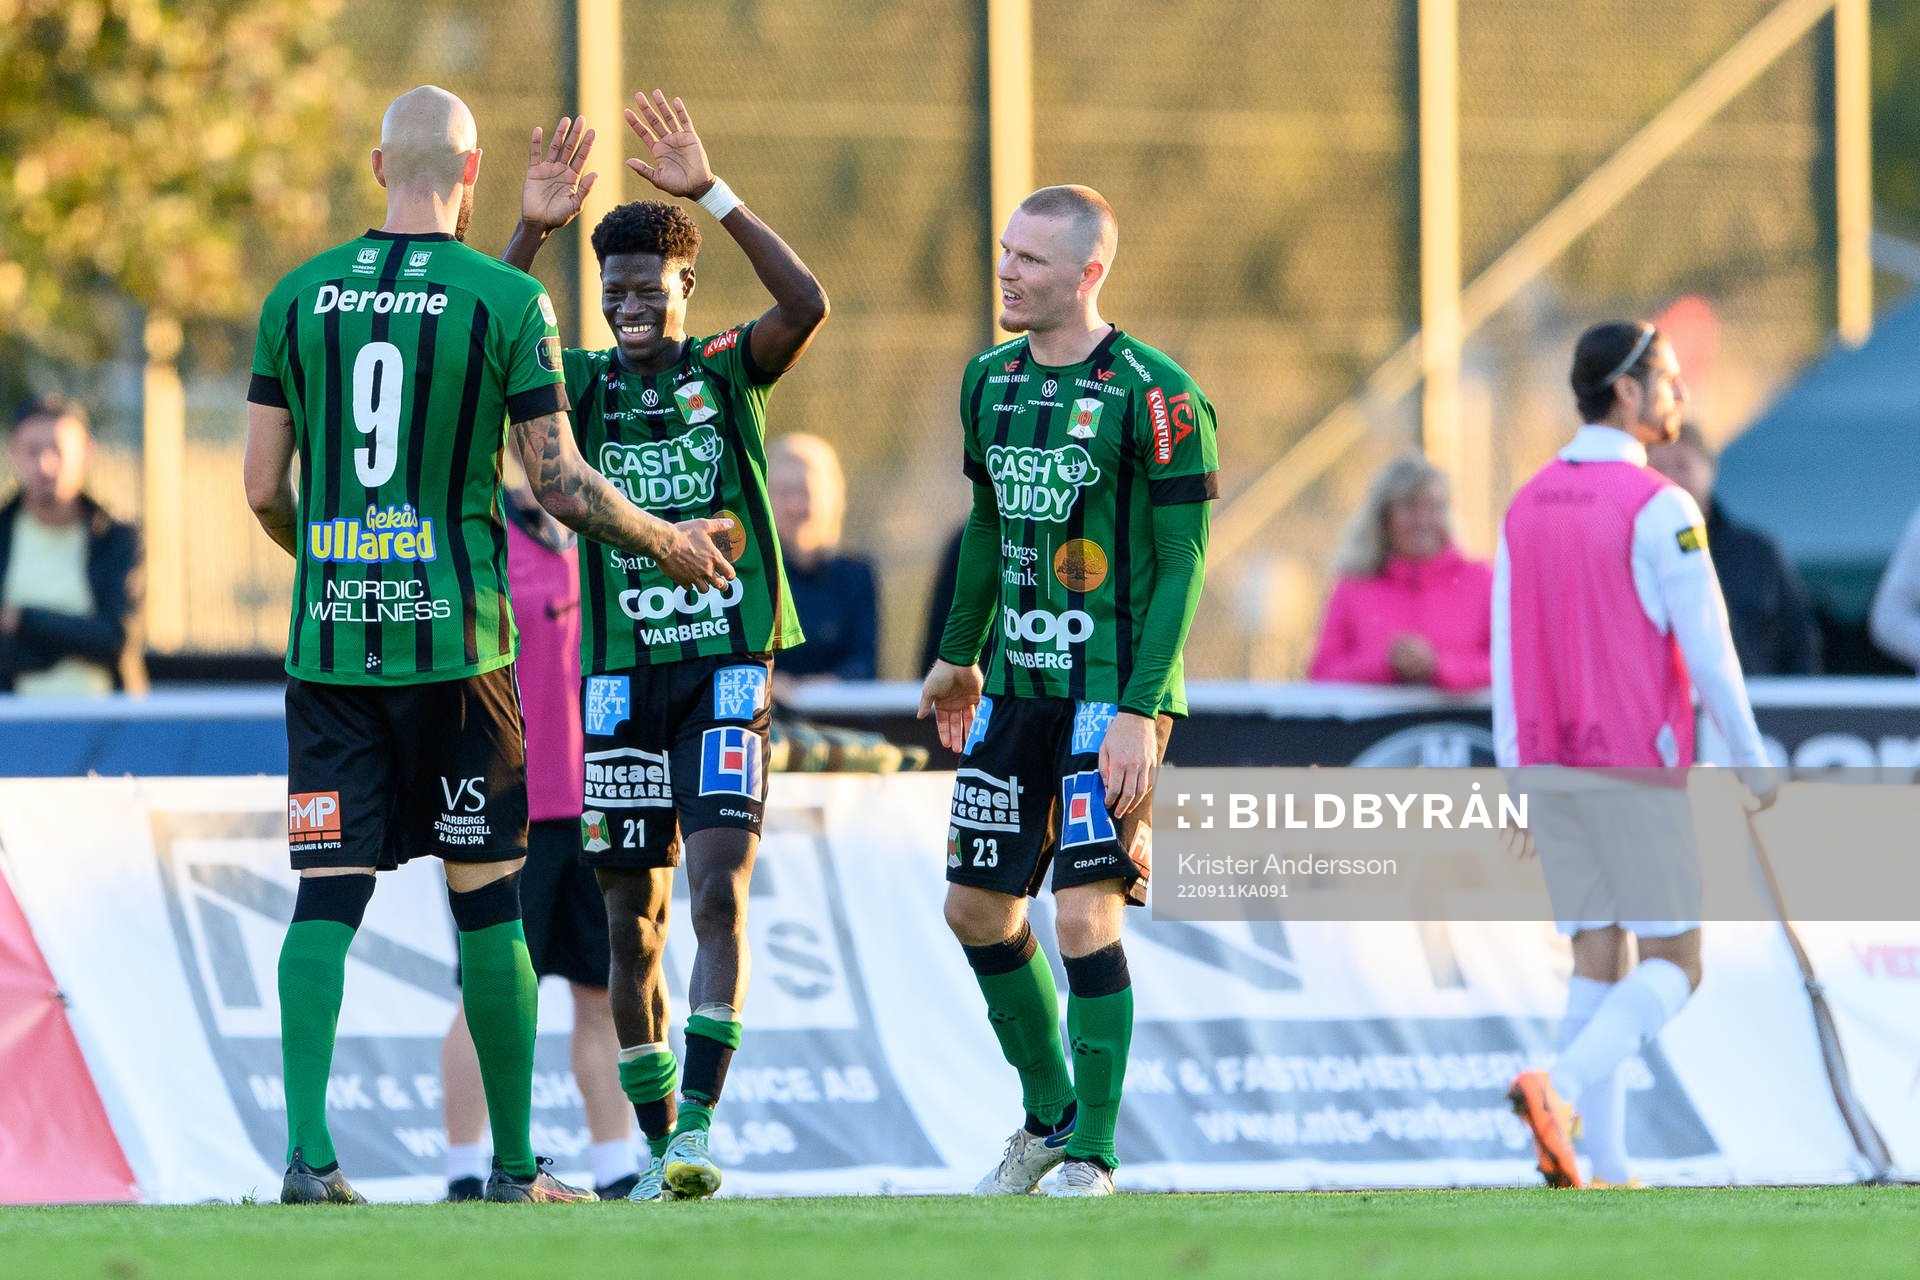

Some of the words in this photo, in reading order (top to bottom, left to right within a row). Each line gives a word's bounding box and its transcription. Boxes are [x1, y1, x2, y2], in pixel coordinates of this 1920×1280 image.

[313, 285, 448, 316] Derome
[1075, 378, 1103, 391] VARBERG
[1103, 384, 1126, 397] ENERGI
[352, 341, 404, 487] 9
[604, 412, 626, 420] RAFT
[992, 404, 1018, 412] CRAFT
[1149, 390, 1170, 460] KVANTUM
[604, 445, 687, 476] CASH
[988, 453, 1052, 484] CASH
[609, 466, 711, 503] BUDDY
[997, 484, 1072, 515] BUDDY
[366, 503, 419, 529] Gekås
[311, 520, 435, 560] Ullared
[326, 579, 424, 600] NORDIC
[618, 576, 744, 620] coop
[309, 600, 451, 622] WELLNESS
[640, 618, 730, 646] VARBERG
[1006, 649, 1073, 670] VARBERG
[586, 749, 671, 785] micael
[440, 776, 486, 812] VS
[585, 784, 673, 798] BYGGARE
[441, 813, 486, 825] VARBERGS
[720, 808, 753, 821] CRAFT
[952, 801, 1020, 824] YGGARE
[434, 821, 492, 835] STADSHOTELL
[439, 832, 446, 842] &
[446, 835, 467, 845] ASIA
[467, 836, 485, 845] SPA
[622, 818, 645, 848] 21
[973, 838, 999, 868] 23
[1074, 856, 1108, 869] CRAFT
